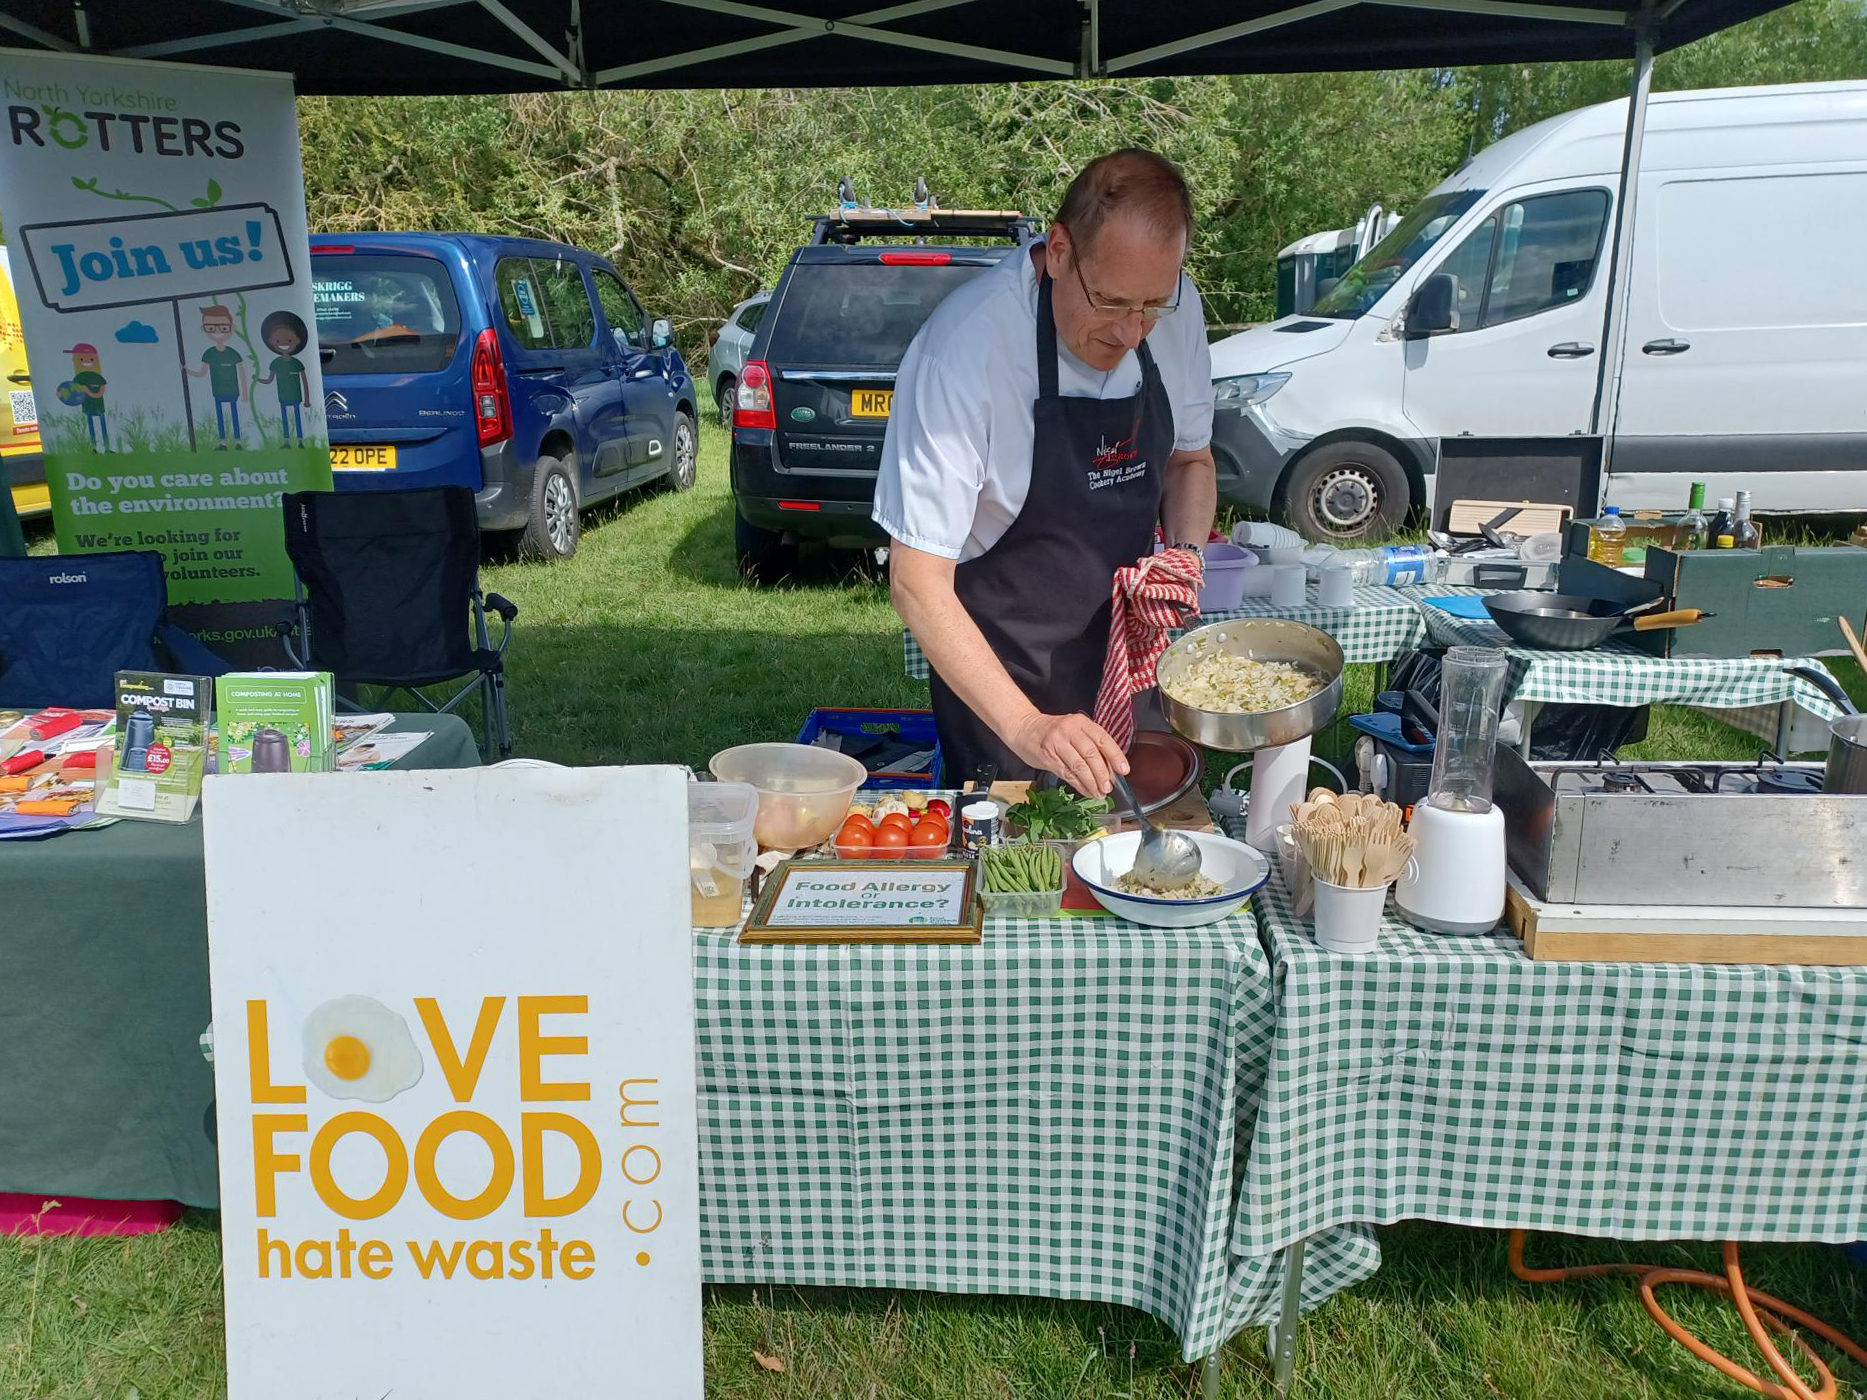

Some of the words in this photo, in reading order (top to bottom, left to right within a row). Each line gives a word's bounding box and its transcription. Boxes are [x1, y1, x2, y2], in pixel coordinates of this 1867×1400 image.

[4, 79, 69, 103] North
[75, 85, 177, 111] Yorkshire
[8, 104, 245, 159] ROTTERS
[51, 236, 172, 296] Join
[179, 220, 263, 269] us!
[312, 281, 352, 292] SKRIGG
[313, 292, 365, 302] EMAKERS
[330, 448, 349, 464] 22
[354, 448, 388, 464] OPE
[788, 442, 862, 452] FREELANDER
[66, 472, 101, 491] Do
[107, 474, 155, 494] you
[160, 471, 213, 488] care
[220, 467, 289, 486] about
[1087, 470, 1101, 481] The
[1103, 467, 1123, 478] Nigel
[1089, 477, 1115, 490] Cookery
[1116, 469, 1146, 483] Academy
[71, 496, 112, 515] the
[118, 491, 283, 514] environment?
[75, 532, 133, 548] We're
[137, 529, 209, 546] looking
[215, 528, 241, 542] for
[173, 548, 208, 566] join
[213, 549, 244, 561] our
[50, 571, 87, 584] rolson
[120, 694, 175, 709] COMPOST
[175, 698, 195, 710] BIN
[795, 881, 855, 891] Food
[861, 881, 951, 893] Allergy
[787, 898, 949, 909] Intolerance?
[251, 1110, 602, 1221] FOOD
[257, 1228, 393, 1279] hate
[405, 1228, 596, 1280] waste
